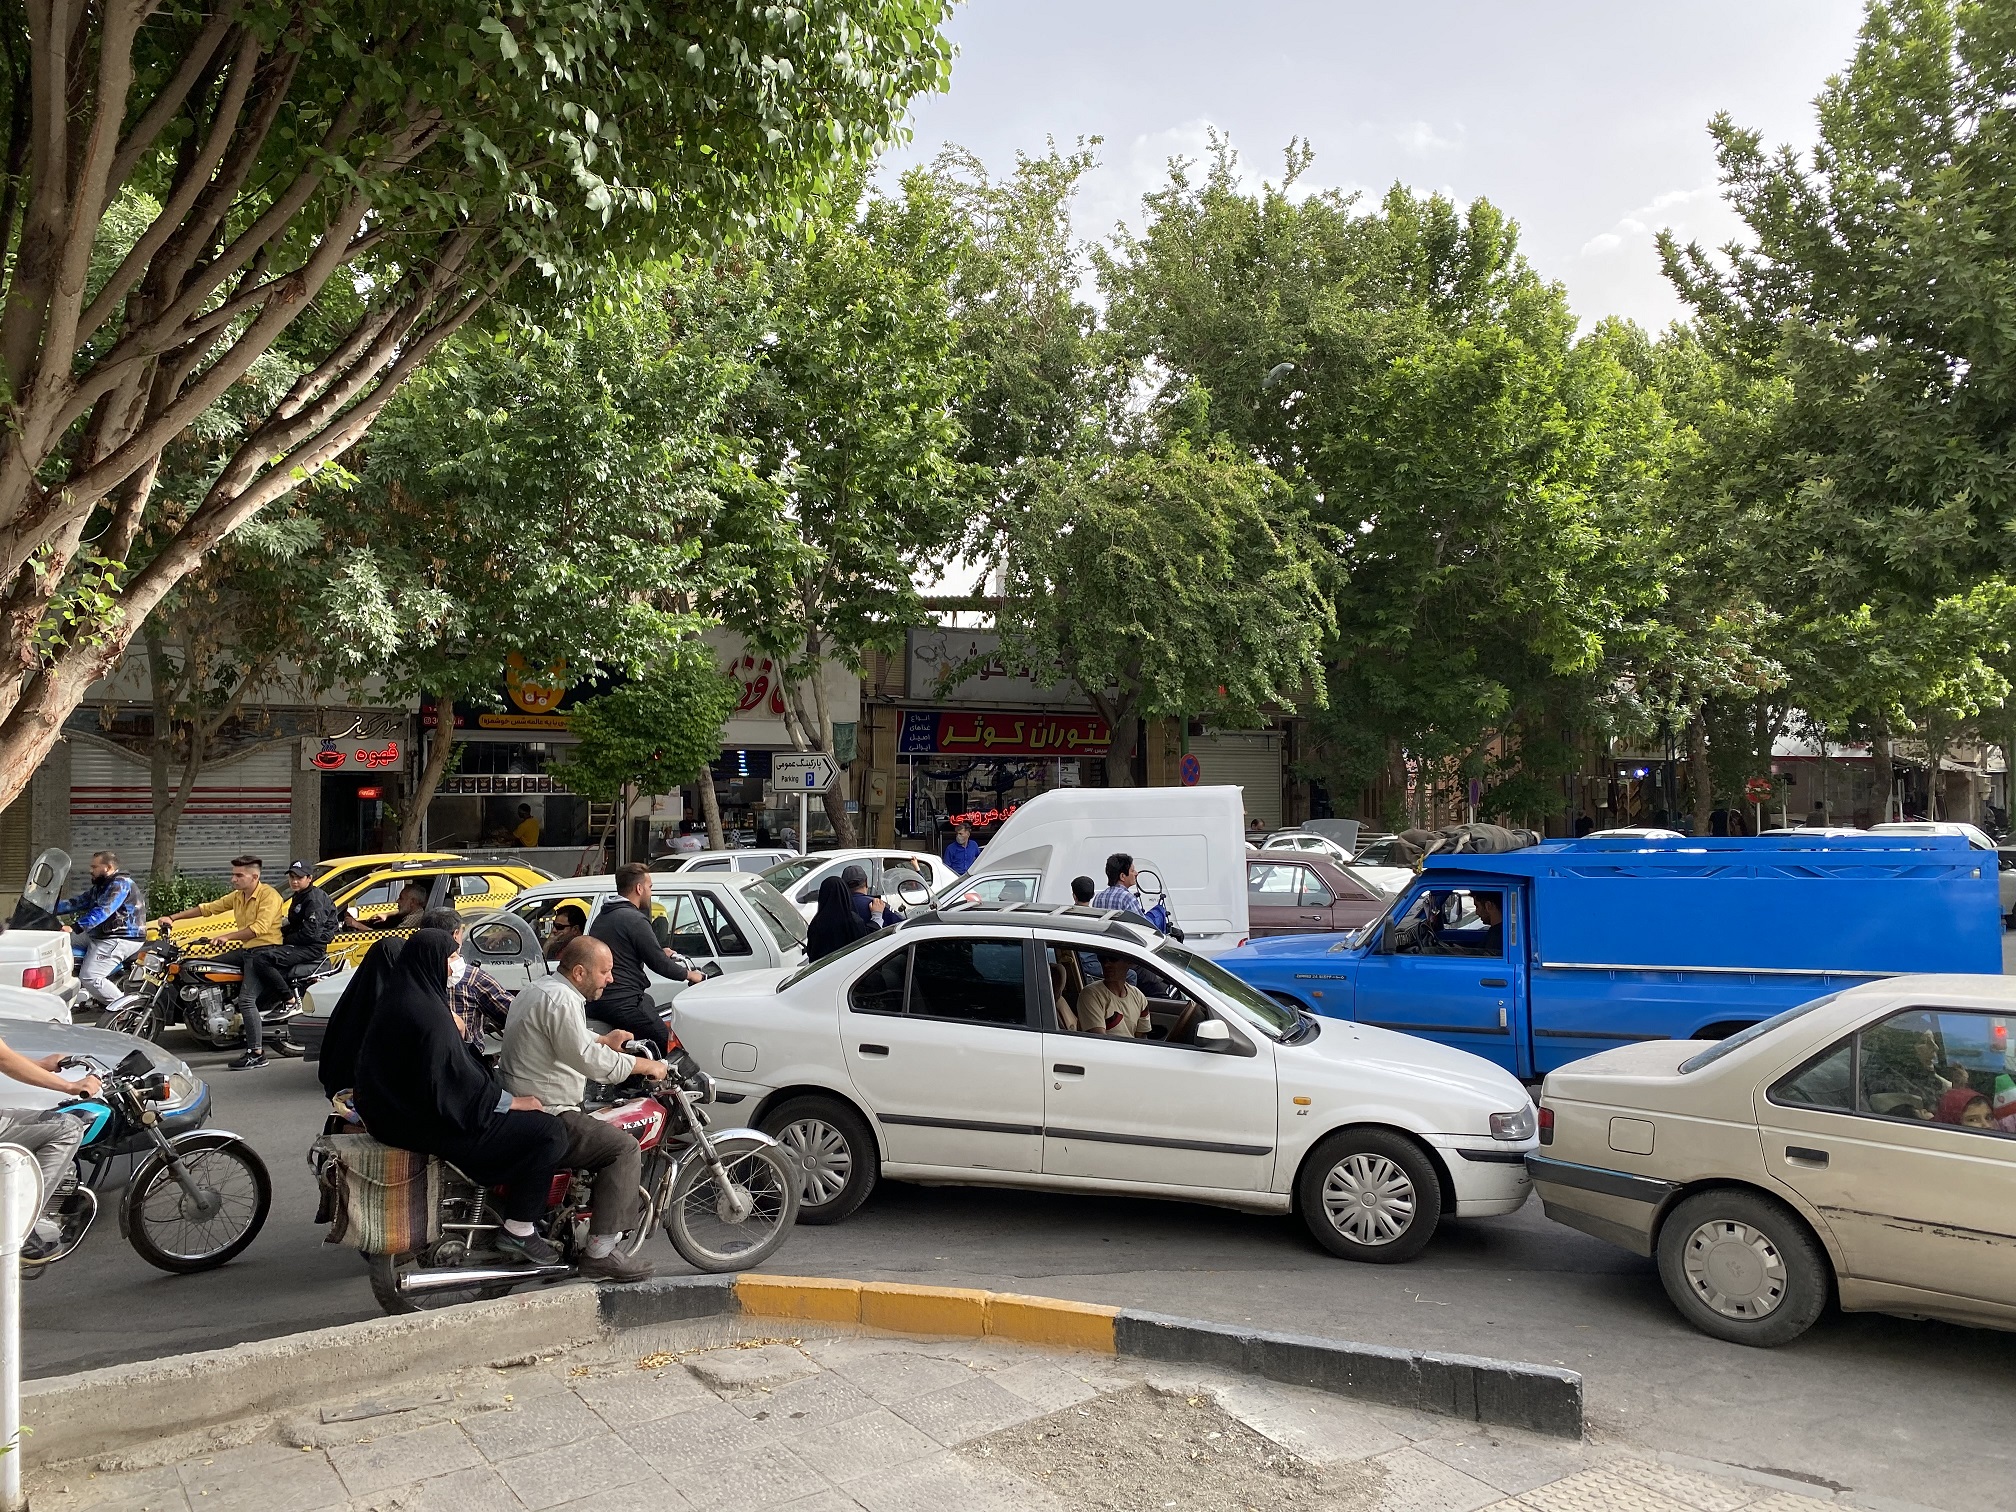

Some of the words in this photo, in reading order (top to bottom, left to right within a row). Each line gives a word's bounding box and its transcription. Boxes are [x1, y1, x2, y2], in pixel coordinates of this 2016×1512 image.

[910, 714, 930, 723] انواع
[909, 724, 931, 732] غذاهای
[941, 715, 1025, 748] کوثر
[909, 733, 931, 742] اصیل
[908, 743, 931, 752] ایرانی
[354, 741, 399, 768] قهوه
[776, 761, 796, 771] عمومی
[796, 758, 822, 771] پارکینگ
[781, 775, 800, 784] Parking
[950, 808, 999, 826] عروسی
